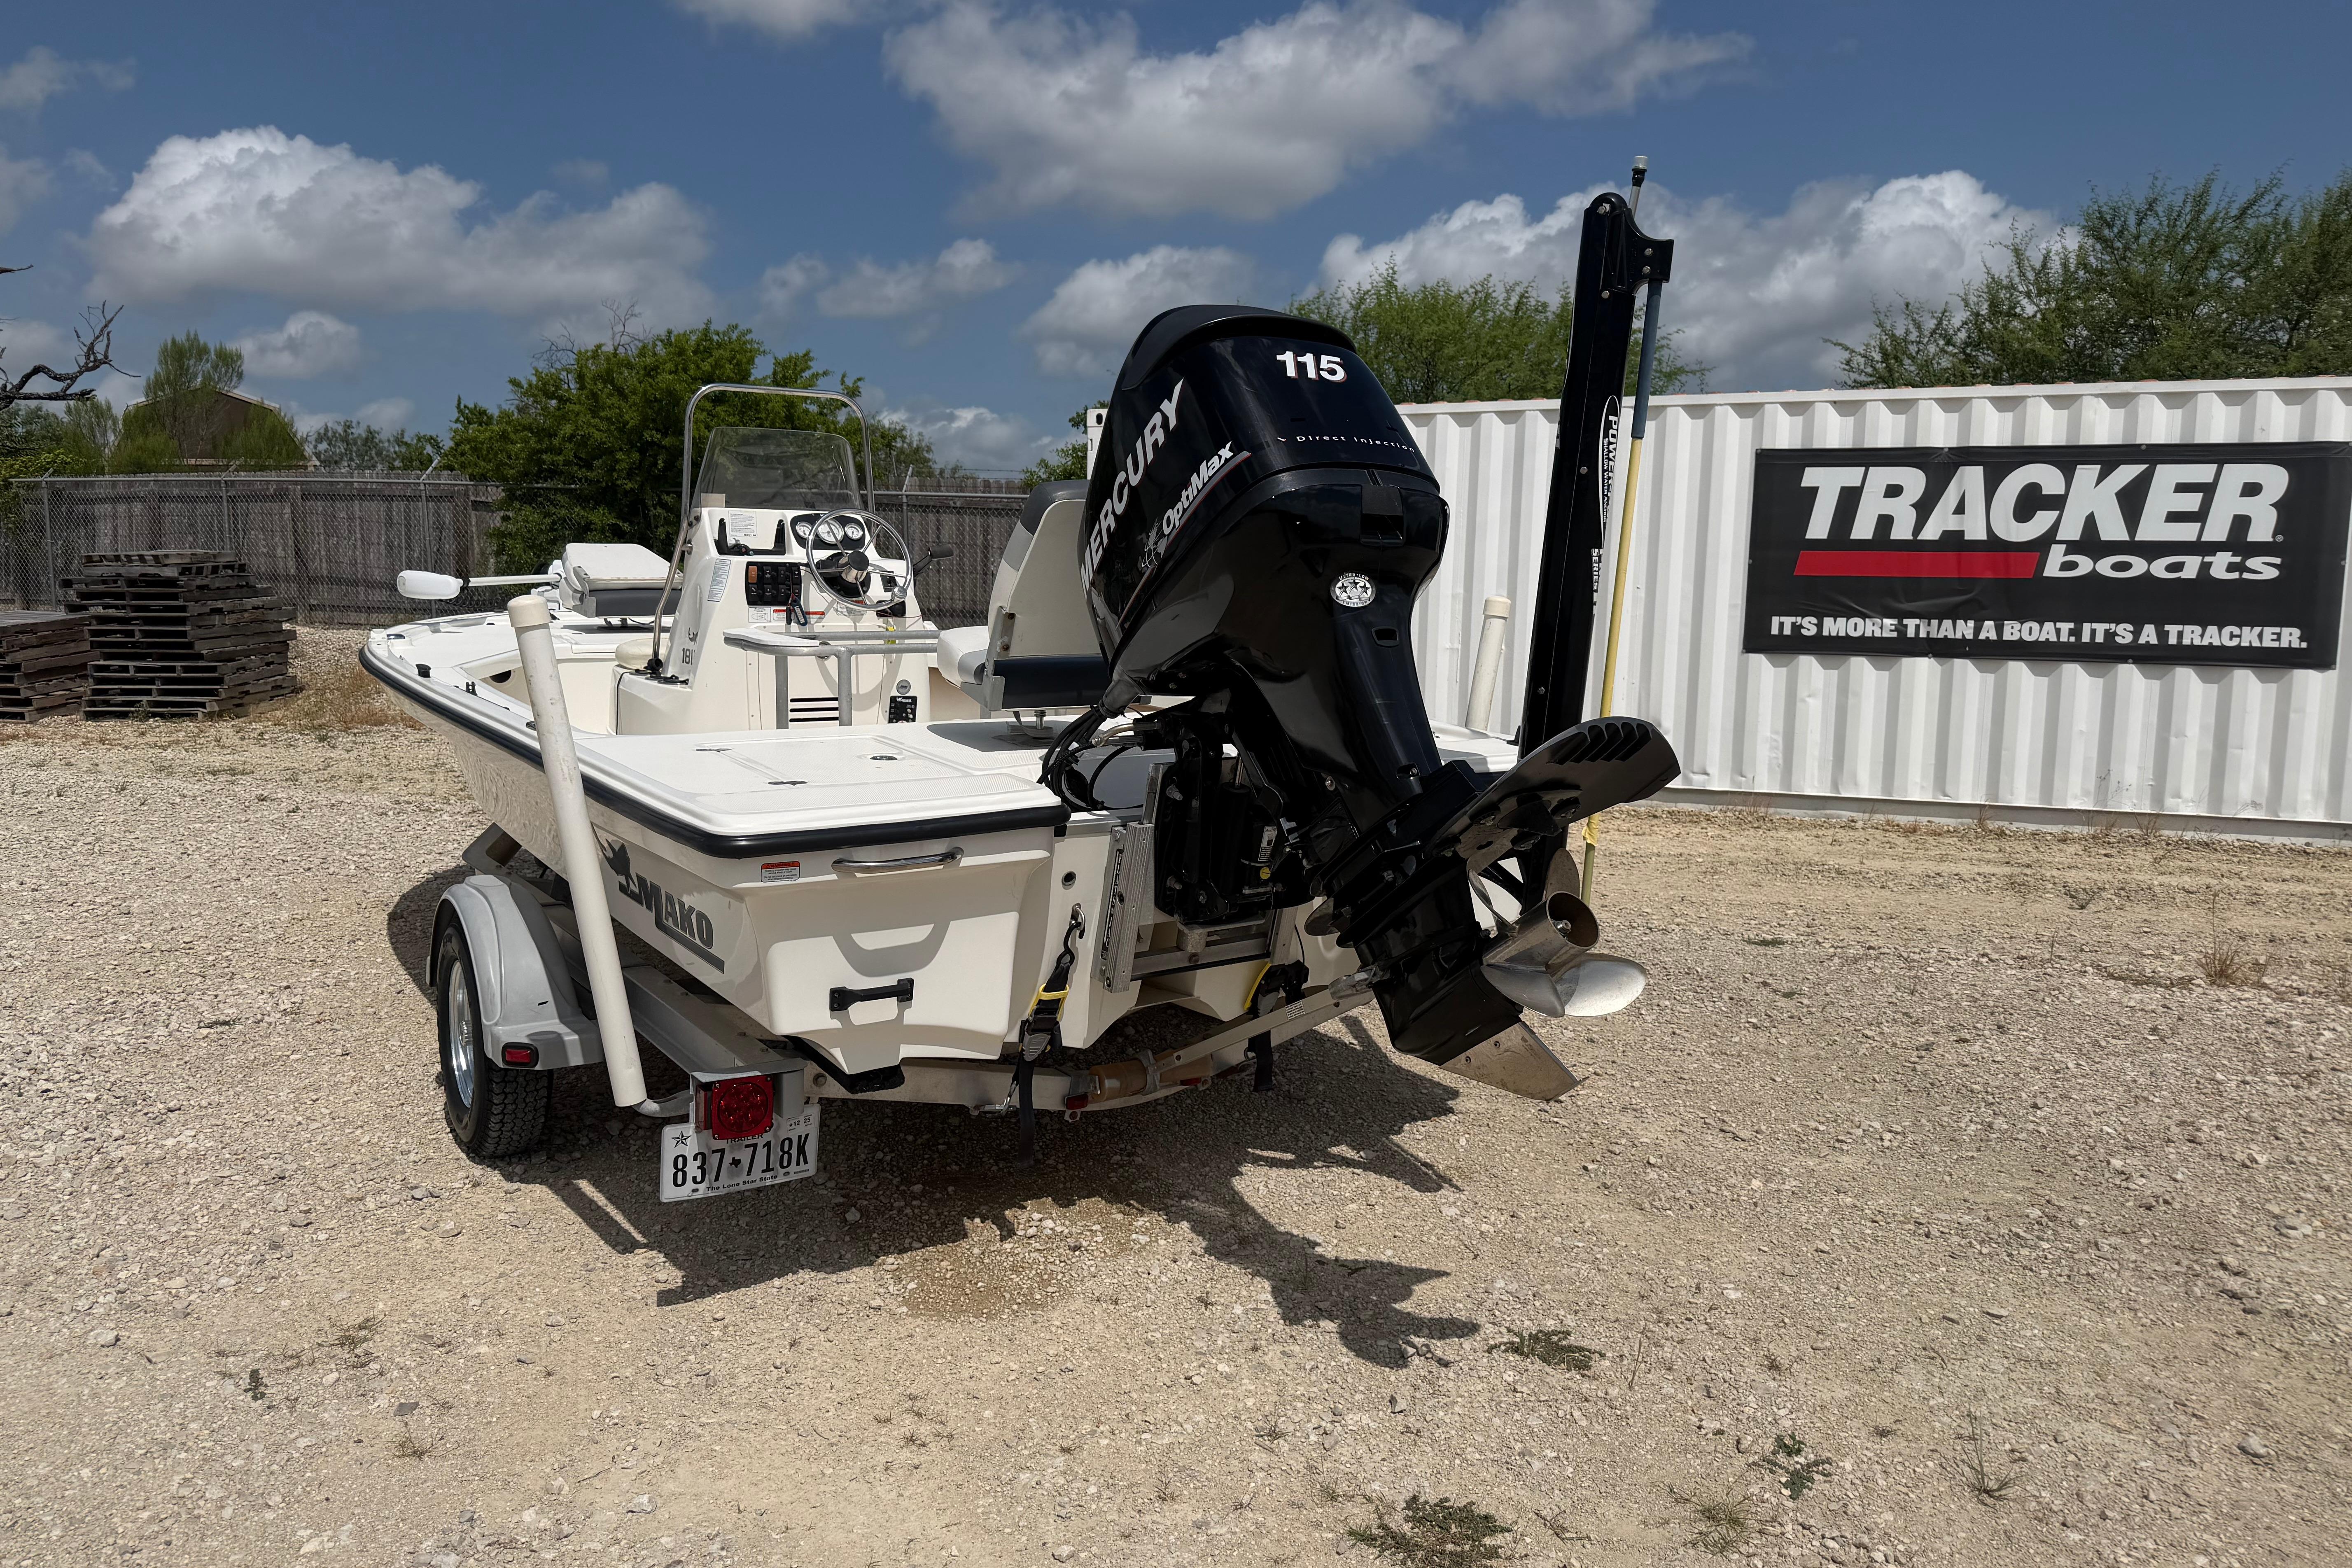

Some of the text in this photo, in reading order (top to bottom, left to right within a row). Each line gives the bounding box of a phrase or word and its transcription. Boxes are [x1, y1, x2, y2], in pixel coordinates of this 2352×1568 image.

[1276, 351, 1346, 382] 115
[1080, 376, 1185, 601] MERCURY
[1163, 441, 1234, 535] OptiMax
[2042, 544, 2282, 580] boats
[1771, 616, 2308, 649] IT'S MORE THAN A BOAT. IT'S A TRACKER.
[618, 872, 719, 957] MAKO
